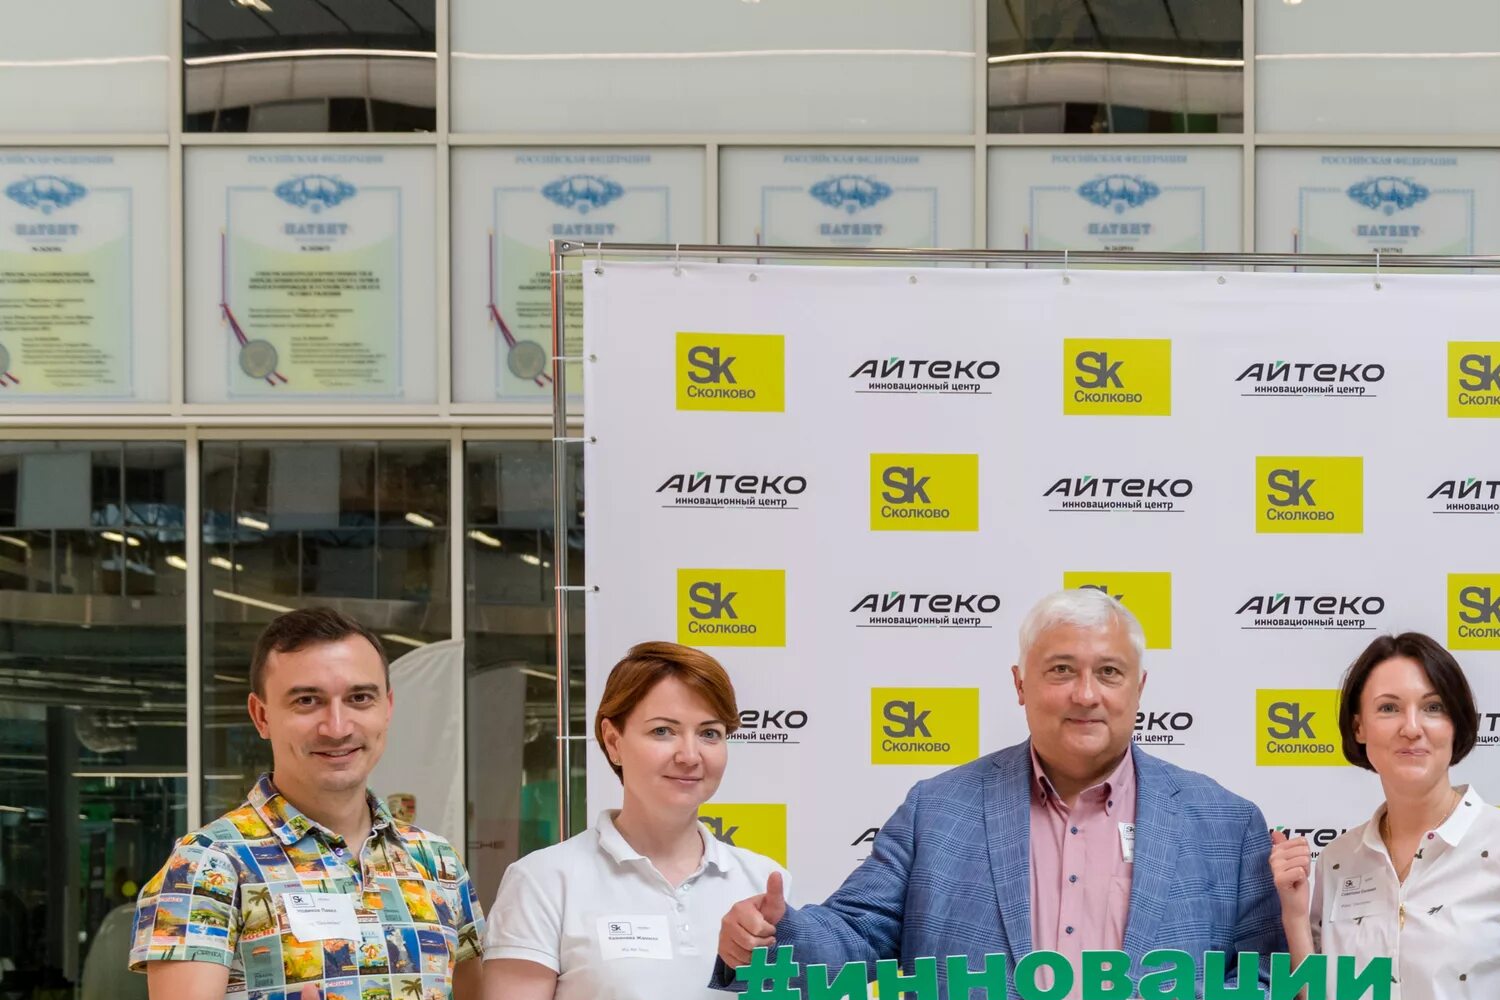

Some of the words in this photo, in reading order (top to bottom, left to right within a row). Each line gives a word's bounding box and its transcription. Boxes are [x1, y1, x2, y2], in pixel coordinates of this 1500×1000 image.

[16, 224, 79, 236] ПАТЕНТ
[284, 223, 348, 235] ПАТЕНТ
[552, 223, 616, 236] ПАТЕНТ
[820, 223, 884, 236] ПАТЕНТ
[1087, 223, 1151, 236] ПАТЕНТ
[1357, 225, 1420, 237] ПАТЕНТ
[688, 346, 737, 384] Sk
[1075, 351, 1124, 388] Sk
[687, 385, 755, 398] Сколково
[869, 382, 949, 391] инновационный
[951, 383, 981, 392] центр
[1255, 385, 1334, 394] инновационный
[1336, 386, 1366, 395] центр
[1074, 390, 1142, 402] Сколково
[882, 466, 931, 504] Sk
[1267, 469, 1316, 506] Sk
[676, 497, 756, 506] инновационный
[758, 498, 788, 507] центр
[1063, 500, 1142, 509] инновационный
[1144, 501, 1174, 510] центр
[881, 506, 949, 518] Сколково
[1267, 508, 1334, 520] Сколково
[689, 582, 738, 619] Sk
[688, 621, 756, 633] Сколково
[870, 616, 950, 625] инновационный
[951, 617, 982, 626] центр
[1255, 617, 1334, 626] инновационный
[1336, 618, 1366, 627] центр
[883, 700, 932, 738] Sk
[1267, 702, 1316, 740] Sk
[759, 734, 789, 743] центр
[1145, 735, 1174, 744] центр
[882, 739, 950, 752] Сколково
[1267, 740, 1334, 753] Сколково
